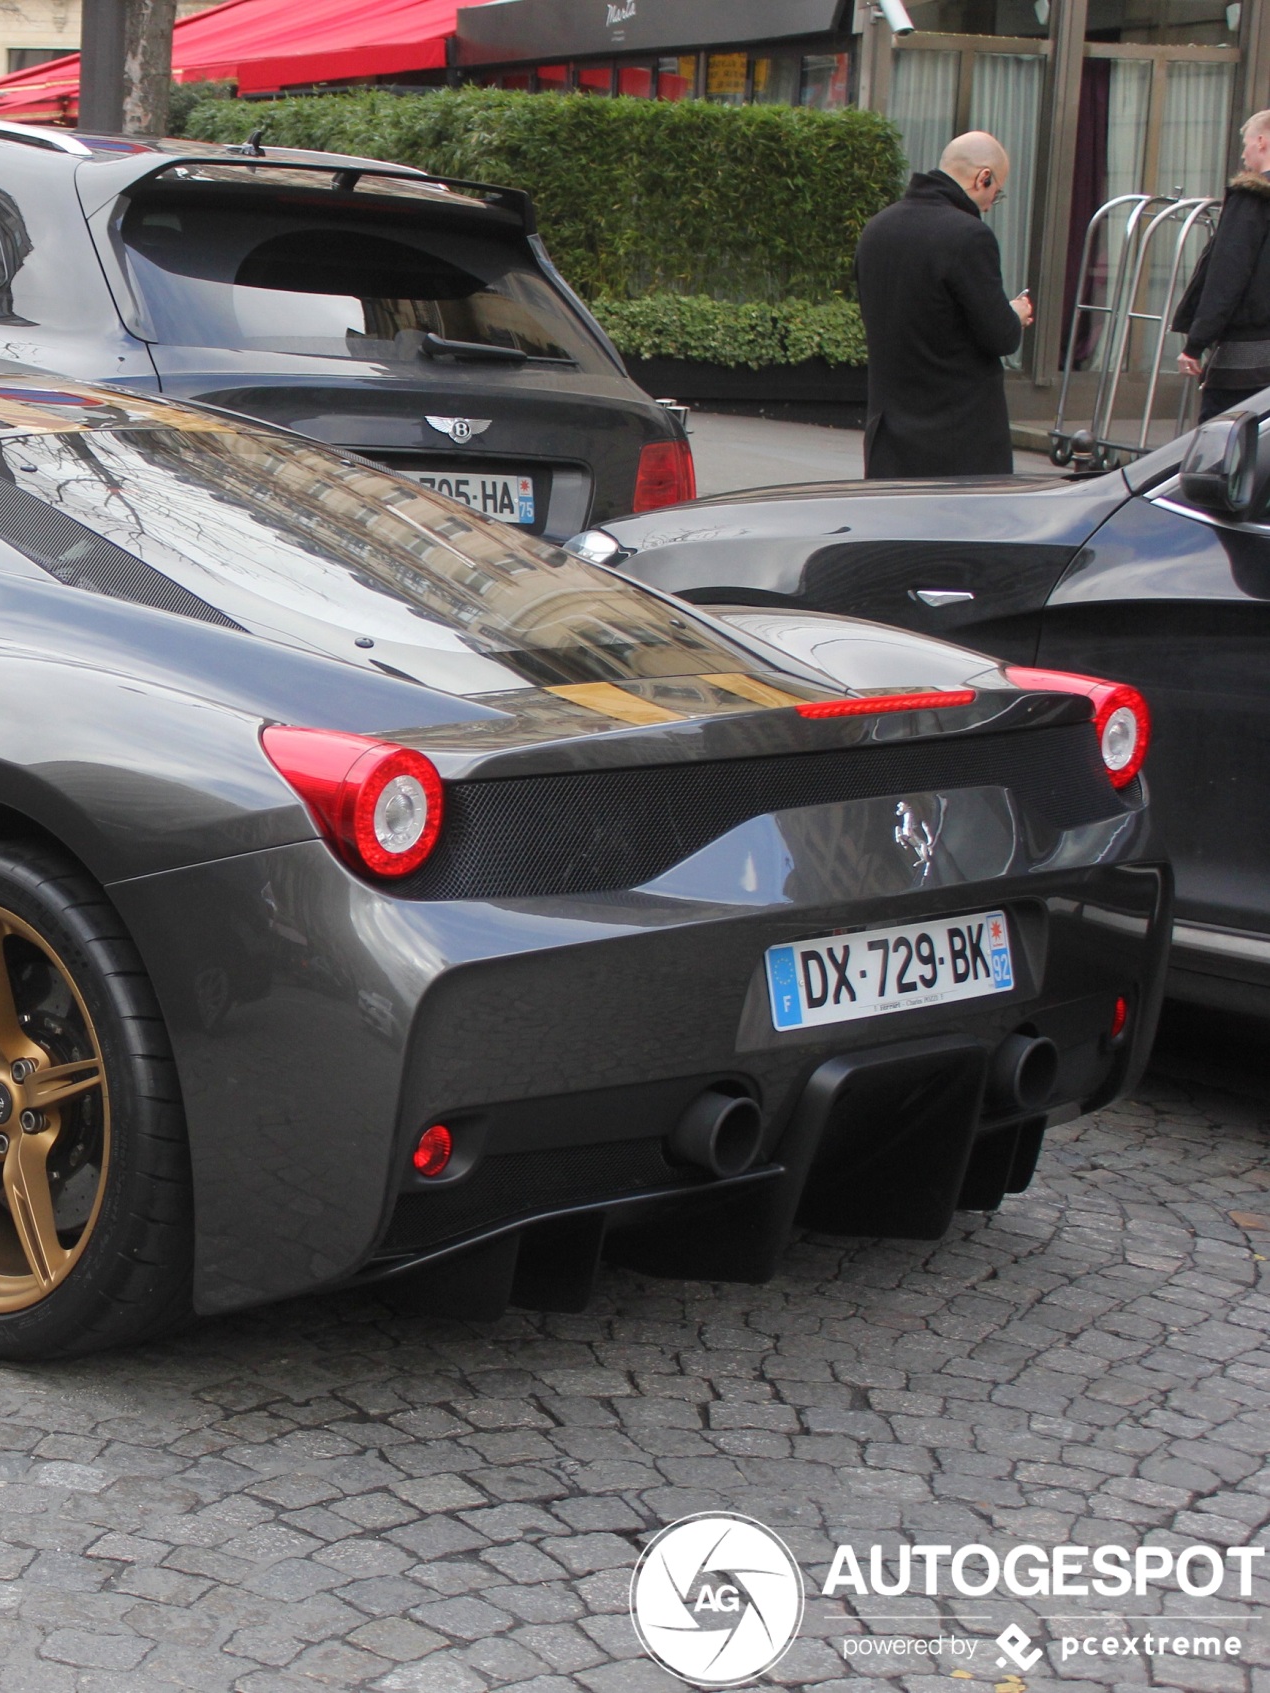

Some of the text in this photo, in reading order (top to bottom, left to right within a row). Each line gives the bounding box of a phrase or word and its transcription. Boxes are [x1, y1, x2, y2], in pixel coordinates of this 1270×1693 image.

[520, 501, 533, 518] 75
[993, 953, 1011, 982] 92
[782, 995, 792, 1013] F
